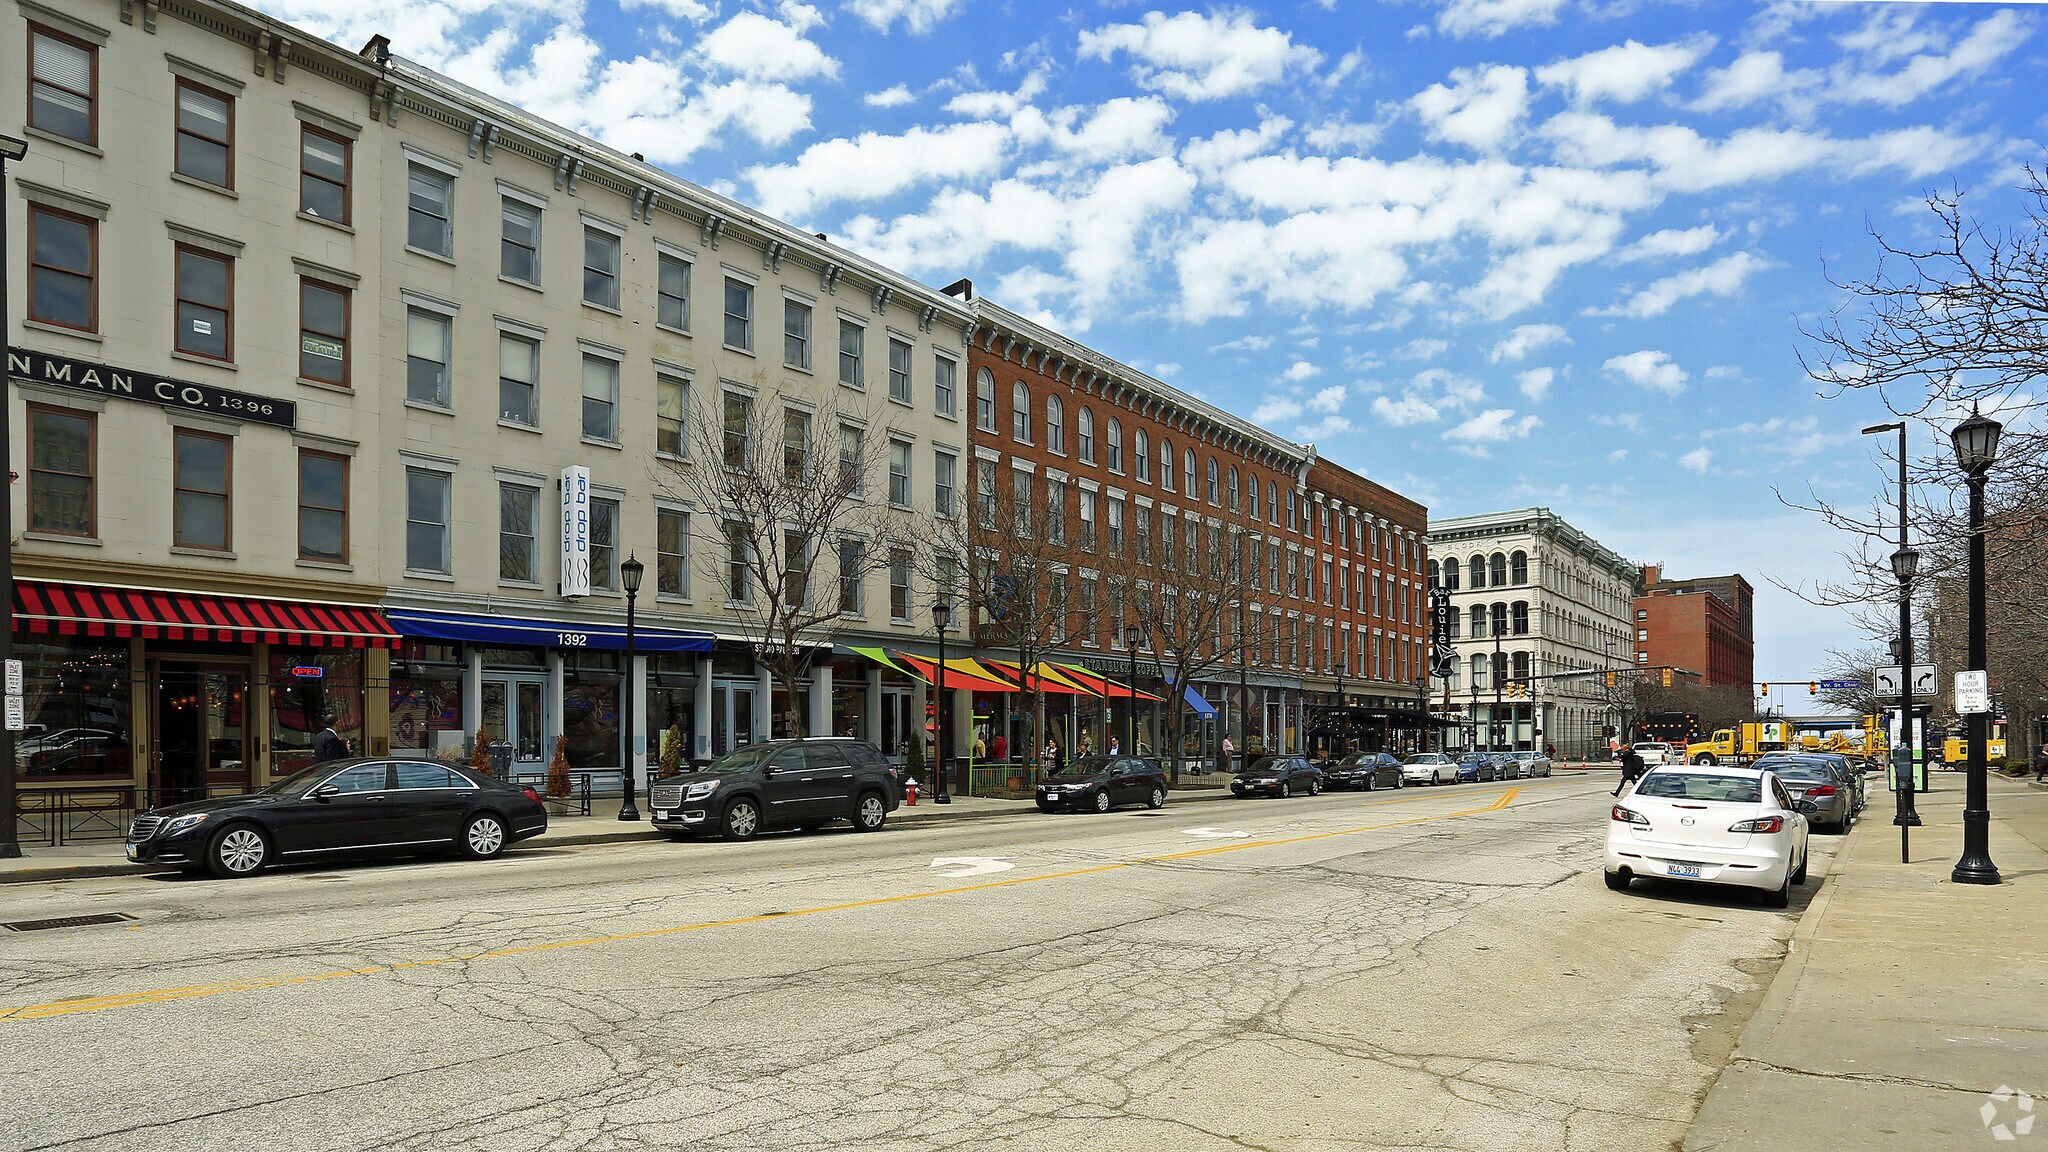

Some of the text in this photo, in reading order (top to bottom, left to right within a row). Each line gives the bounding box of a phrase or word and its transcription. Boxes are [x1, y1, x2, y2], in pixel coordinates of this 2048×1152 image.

[154, 382, 210, 408] CO.
[219, 395, 273, 416] 1396
[563, 474, 571, 553] drop bar
[575, 472, 588, 552] drop bar
[1434, 587, 1451, 597] Bar
[1437, 596, 1447, 644] Louie
[557, 632, 587, 646] 1392
[292, 667, 321, 676] OPEN
[1135, 664, 1161, 676] COFFE
[1964, 673, 1977, 681] TWO
[1962, 680, 1979, 688] HOUR
[1958, 687, 1984, 695] PARKING
